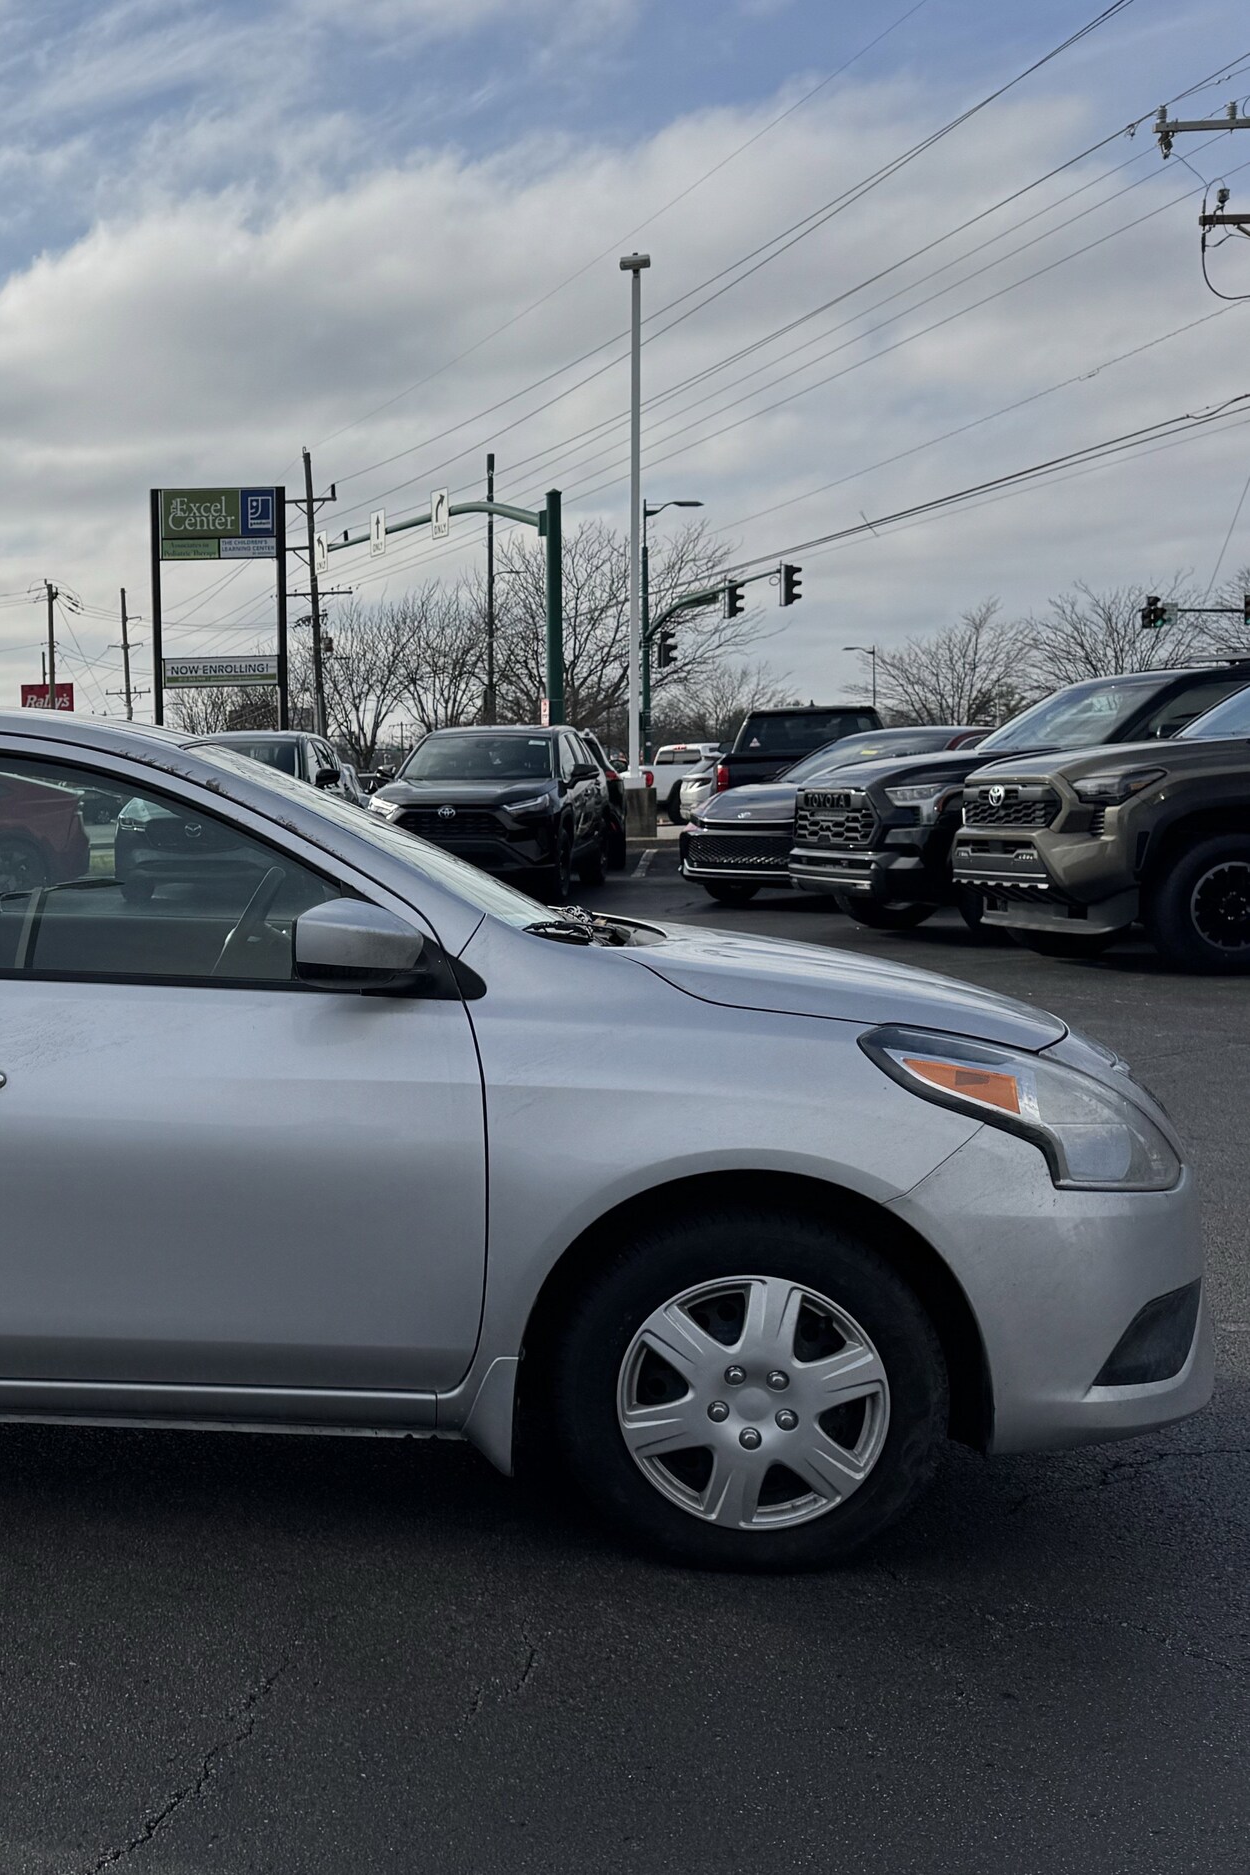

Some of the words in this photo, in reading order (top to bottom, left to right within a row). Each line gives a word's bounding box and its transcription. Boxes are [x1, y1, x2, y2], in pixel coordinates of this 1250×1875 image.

[175, 496, 227, 517] Excel
[168, 512, 235, 530] Center
[434, 523, 447, 535] ONLY
[171, 665, 199, 675] NOW
[202, 663, 269, 674] ENROLLING!
[807, 794, 845, 807] TOYOTA
